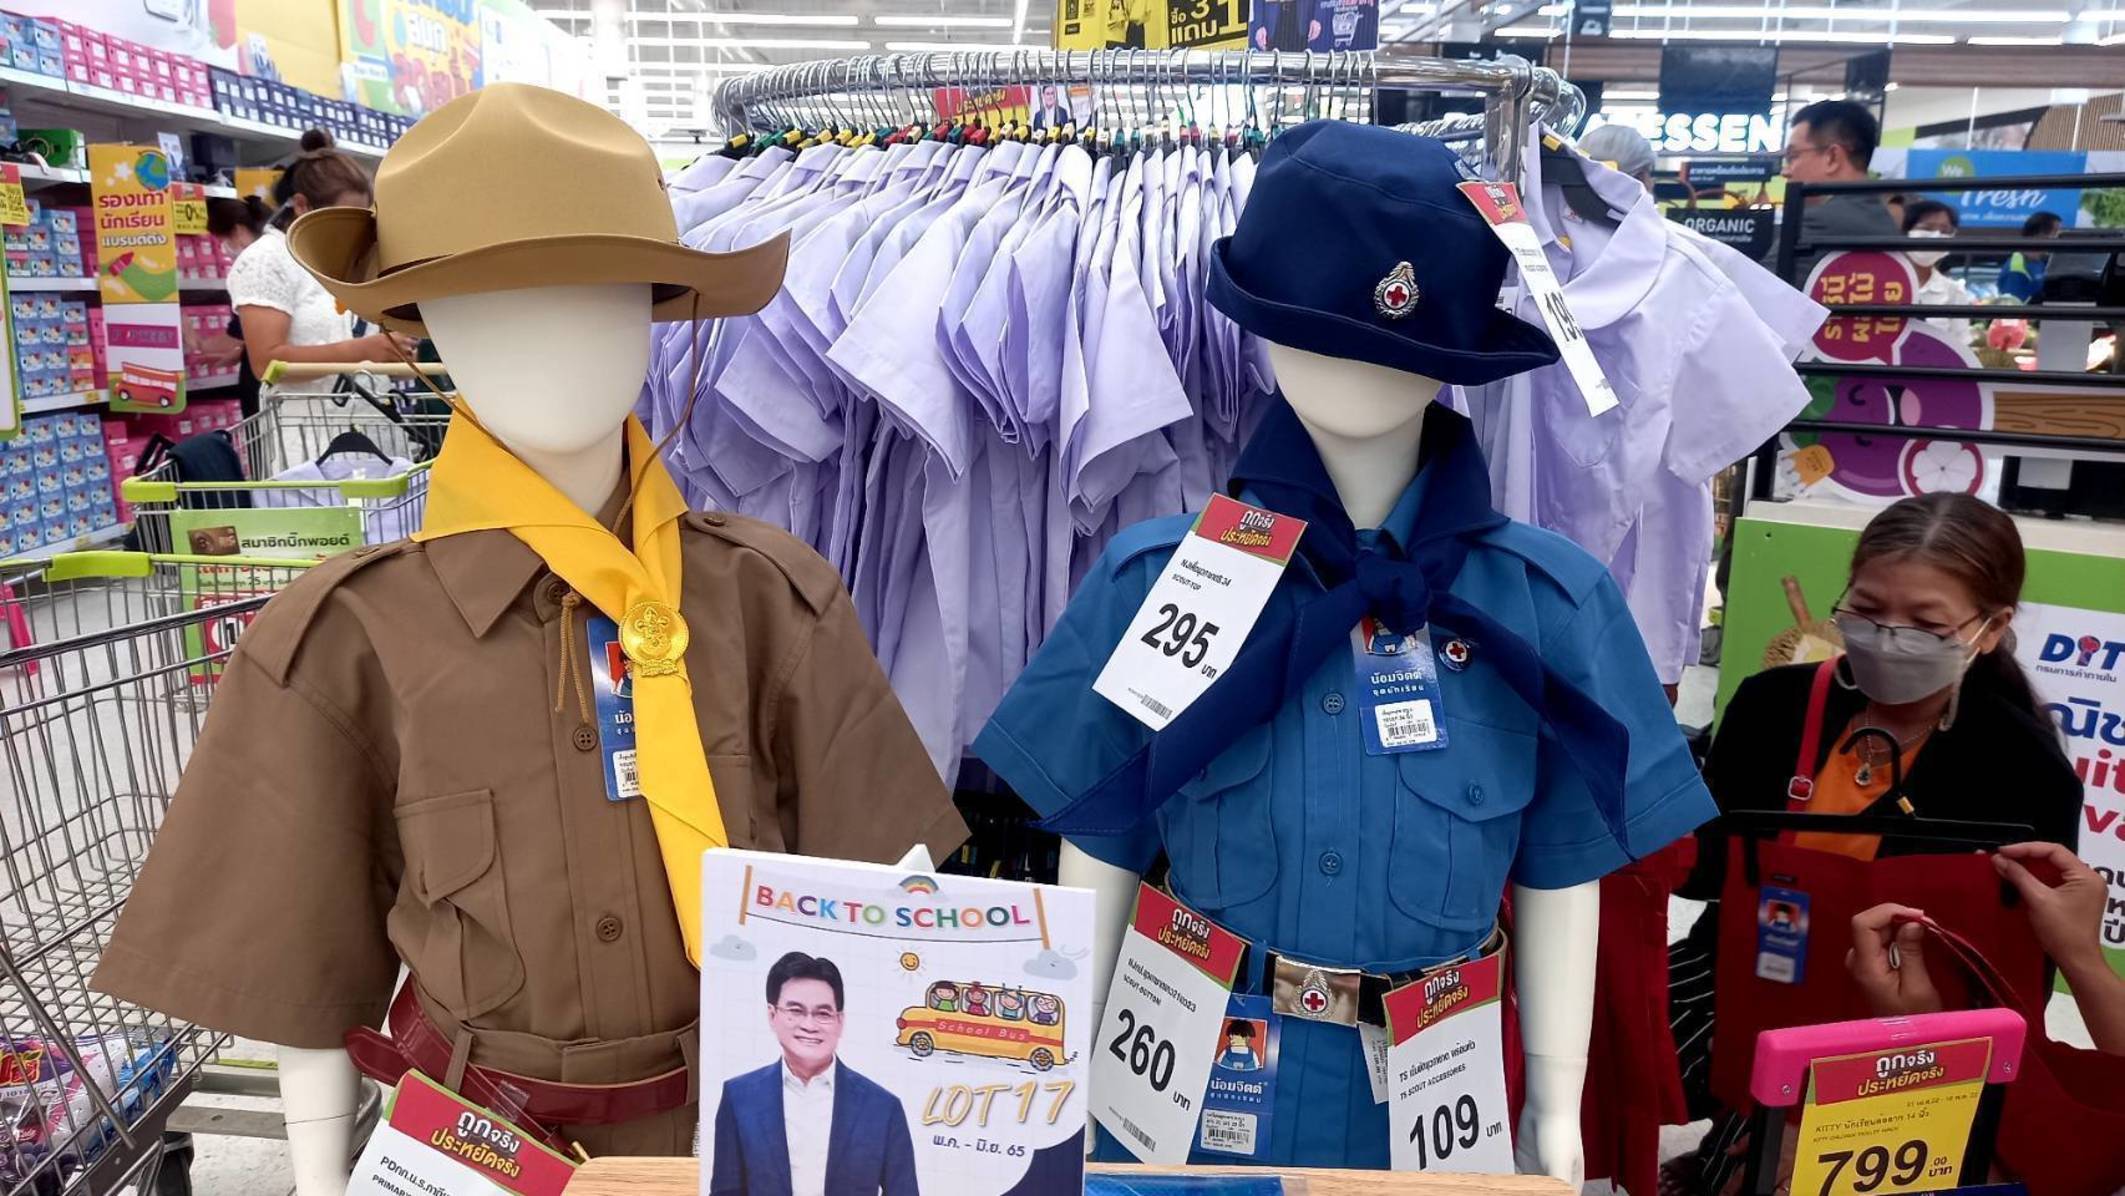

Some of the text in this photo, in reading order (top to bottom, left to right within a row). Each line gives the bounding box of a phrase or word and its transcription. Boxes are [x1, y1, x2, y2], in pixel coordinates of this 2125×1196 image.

[1171, 19, 1217, 44] แถม
[101, 211, 165, 229] นักเรียน
[1685, 217, 1756, 234] ORGANIC
[241, 532, 350, 549] สมาชิกบิ๊กพอยต์
[1140, 603, 1220, 680] 295 บาท
[756, 885, 1031, 928] BACK TO SCHOOL
[1172, 908, 1211, 939] ถูกจริง
[1157, 924, 1211, 960] ประหยัดจริง
[1424, 970, 1461, 1005] ถูกจริง
[1416, 986, 1469, 1029] ประหยัดจริง
[937, 1020, 1026, 1041] School Bus
[1109, 1008, 1191, 1111] 260 บาท
[1876, 1050, 1936, 1077] ถูกจริง
[1210, 1077, 1262, 1095] น้อมจิตต์
[1857, 1065, 1944, 1097] ประหยัดจริง
[921, 1079, 1076, 1128] LOT 17
[457, 1110, 521, 1154] ถูกจริง
[933, 1135, 960, 1148] พ.ค.
[976, 1138, 1002, 1154] มิ.ย.
[1007, 1145, 1026, 1157] 65
[1409, 1094, 1502, 1171] 109 บาท
[430, 1127, 521, 1179] ประหยัดจริง
[1818, 1139, 1929, 1196] 799
[1928, 1165, 1953, 1178] บาท
